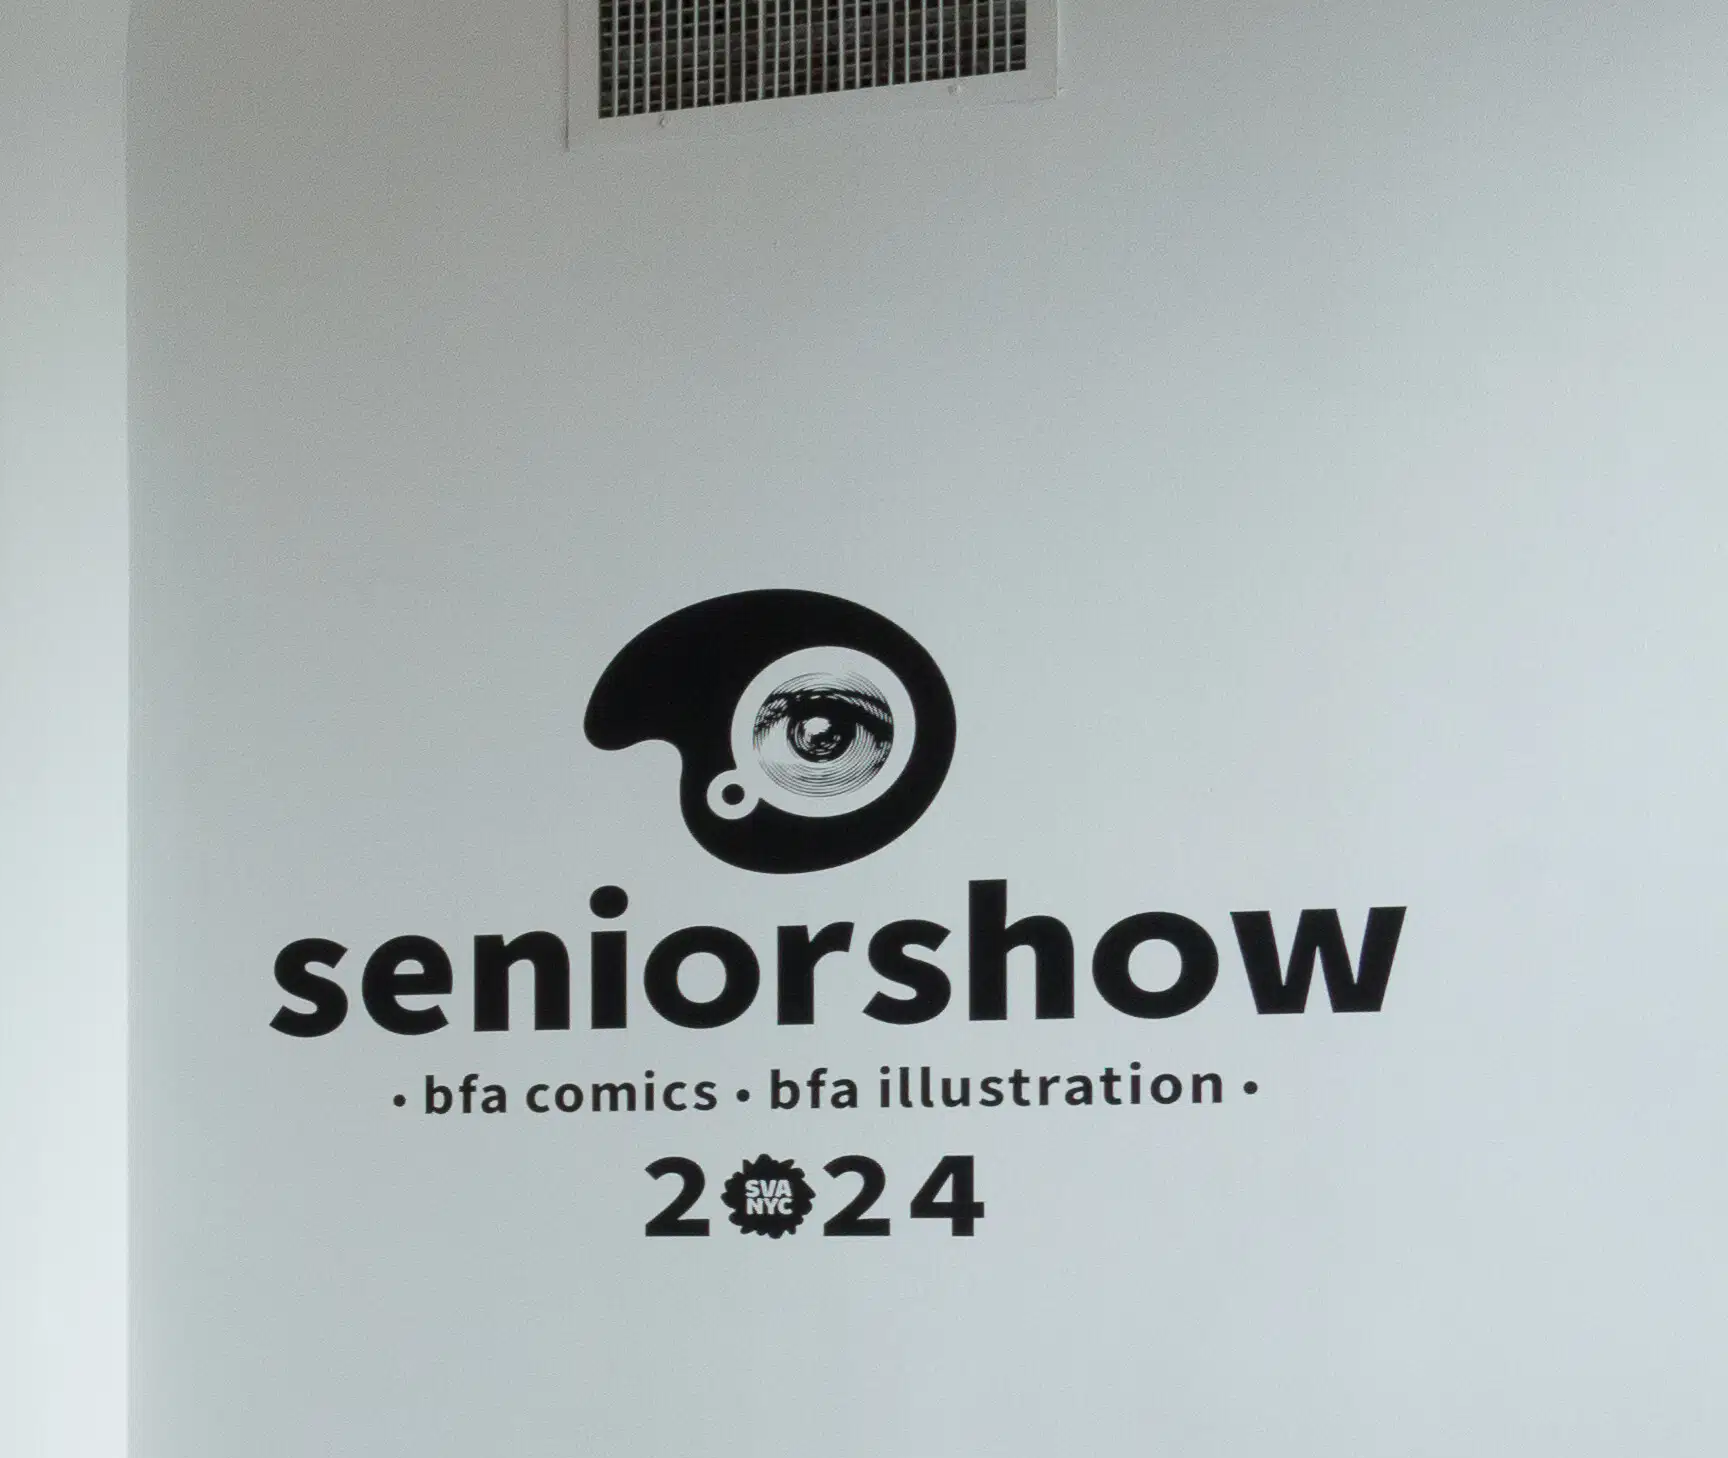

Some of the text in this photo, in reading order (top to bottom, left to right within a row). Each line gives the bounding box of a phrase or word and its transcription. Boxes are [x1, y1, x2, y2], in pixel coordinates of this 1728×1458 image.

[269, 878, 1407, 1038] seniorshow
[424, 1061, 1224, 1115] bfa comics bfa illustration
[745, 1179, 793, 1198] SVA
[746, 1197, 793, 1215] NYC
